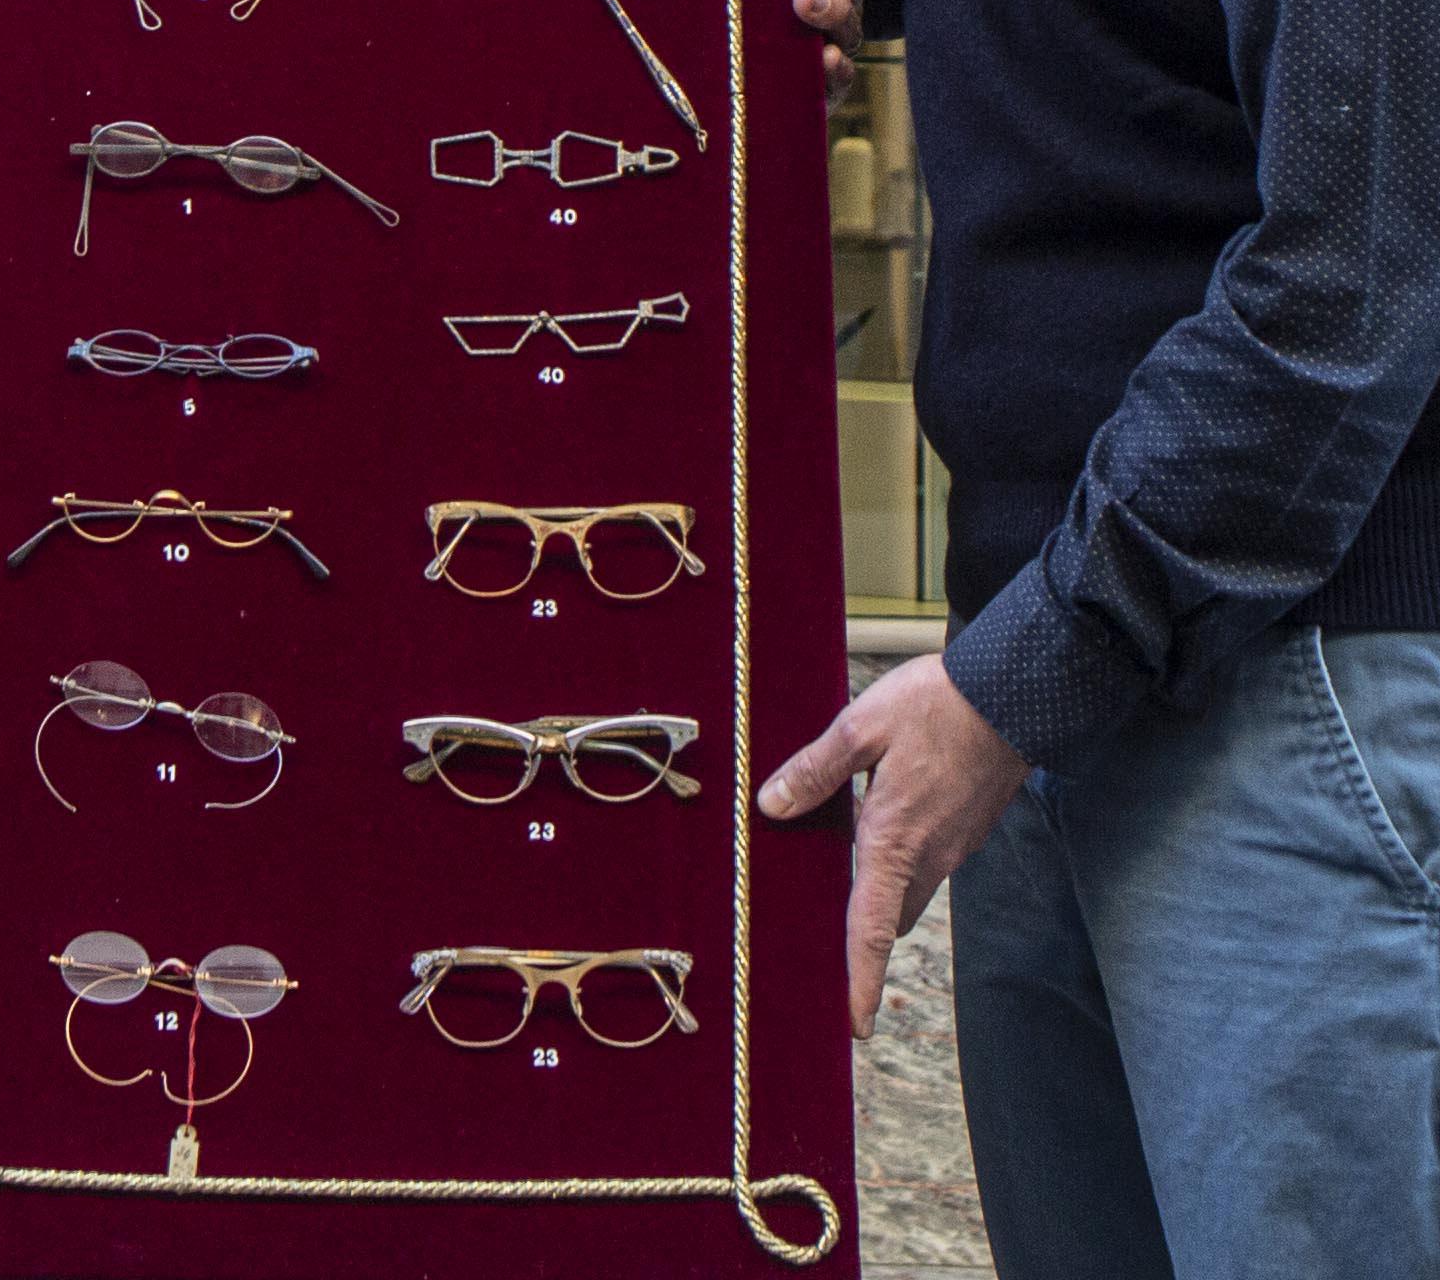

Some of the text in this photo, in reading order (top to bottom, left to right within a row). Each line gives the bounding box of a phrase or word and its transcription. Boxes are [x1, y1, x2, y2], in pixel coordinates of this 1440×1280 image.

[182, 198, 193, 215] 1
[549, 208, 578, 226] 40
[538, 366, 565, 384] 40
[183, 397, 196, 416] 5
[163, 543, 190, 562] 10
[532, 598, 559, 618] 23
[156, 762, 177, 783] 11
[528, 821, 555, 842] 23
[154, 1011, 179, 1031] 12
[532, 1047, 559, 1068] 23
